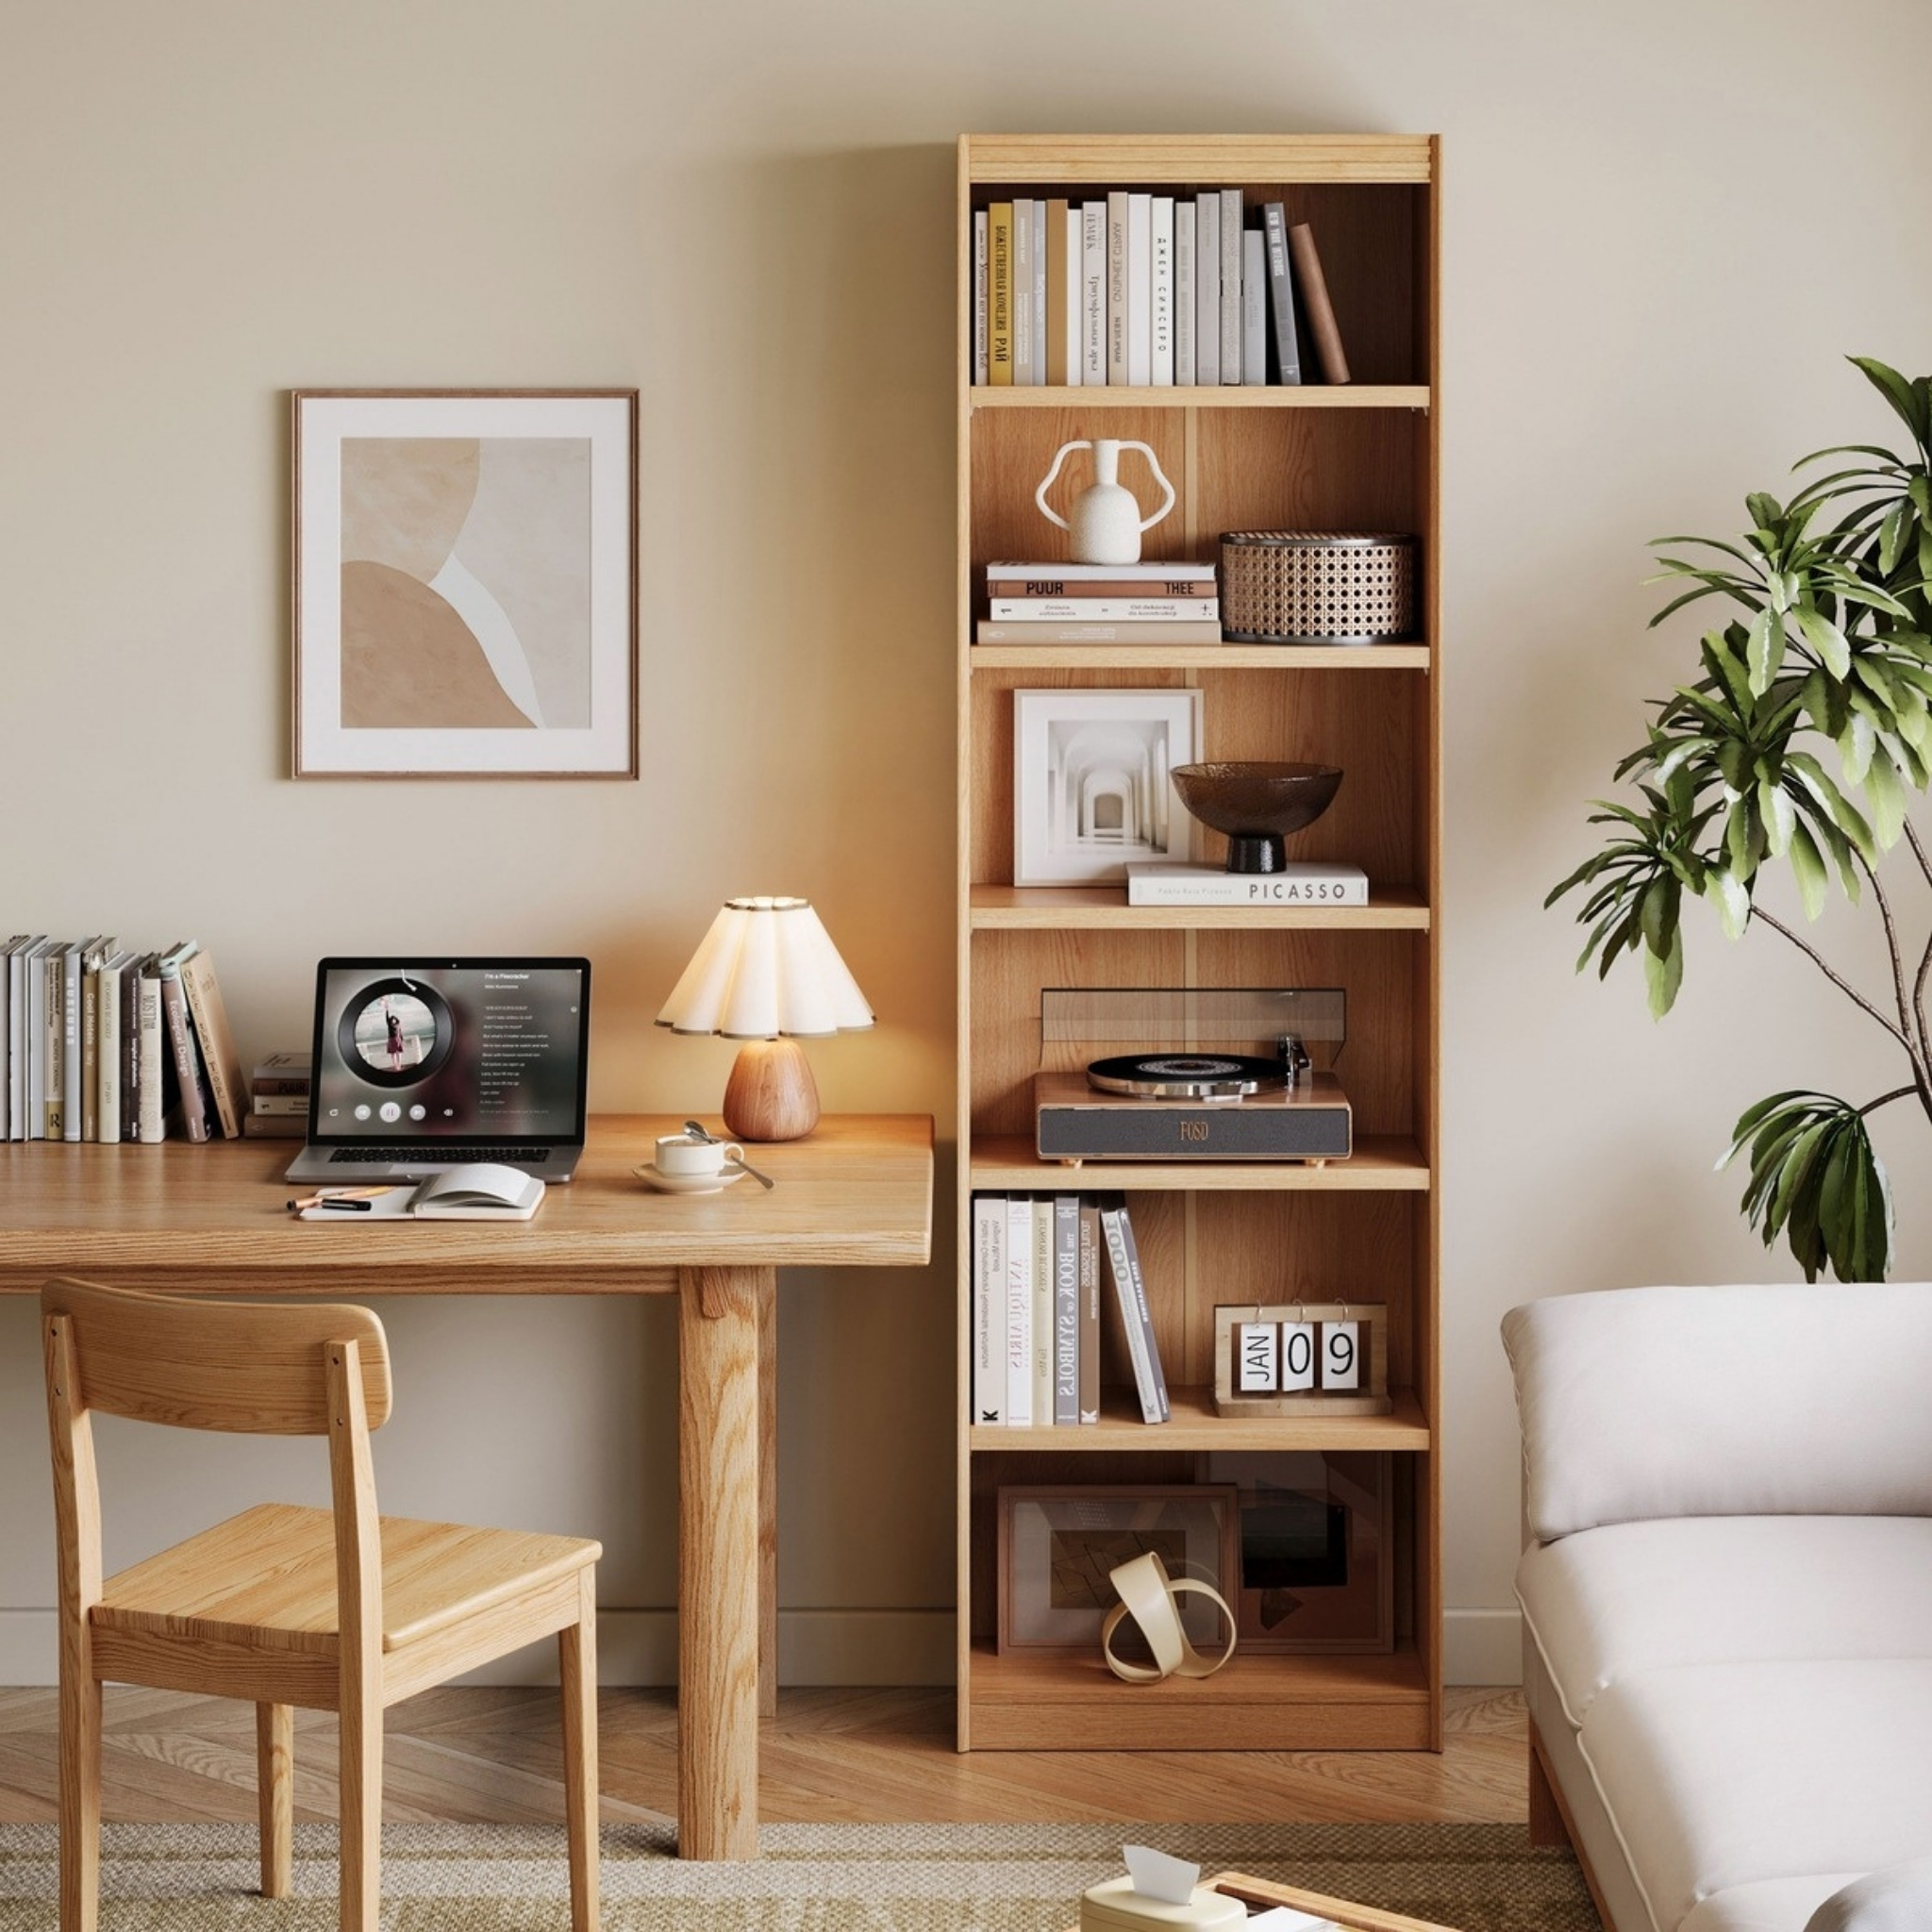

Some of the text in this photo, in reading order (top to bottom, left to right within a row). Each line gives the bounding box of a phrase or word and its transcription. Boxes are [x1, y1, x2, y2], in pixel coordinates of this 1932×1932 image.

[1269, 211, 1279, 225] NEW
[1270, 228, 1282, 243] YORK
[995, 225, 1009, 361] БОЖЕСТВЕННАЯ КОМЕДИЯ РАЙ
[1158, 238, 1166, 351] ДЖЕН СИНСЕРО
[1089, 275, 1100, 371] Триумфальная арка
[1026, 582, 1193, 594] PUUR THEE
[1249, 884, 1345, 898] PICASSO
[86, 993, 94, 1015] Cool
[86, 1016, 94, 1045] Hotels
[170, 1000, 188, 1077] Ecological Design
[1246, 1332, 1353, 1382] JAN 0 9
